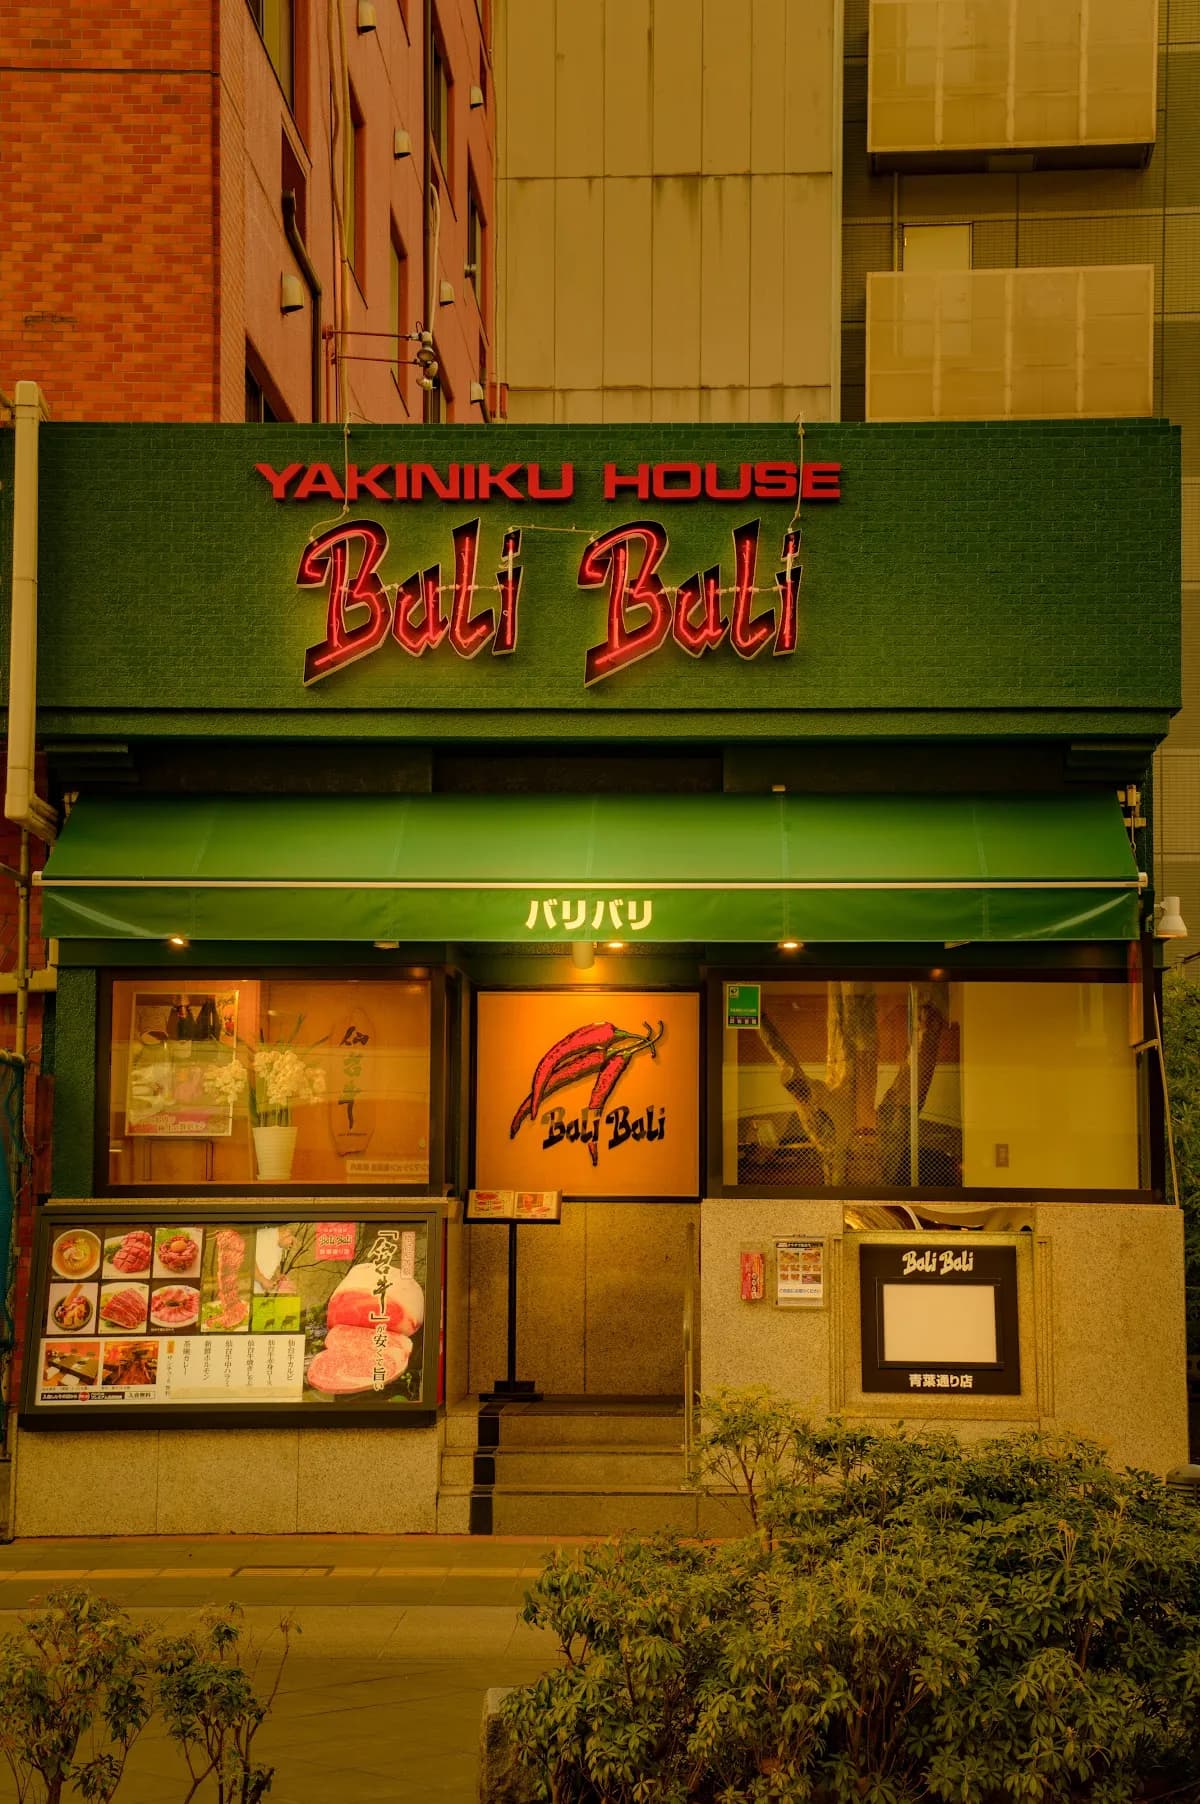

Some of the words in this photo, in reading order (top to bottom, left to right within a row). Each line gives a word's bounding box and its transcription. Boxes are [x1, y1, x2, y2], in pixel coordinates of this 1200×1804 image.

[255, 463, 574, 499] YAKINIKU
[604, 463, 841, 499] HOUSE
[296, 517, 521, 687] Bali
[576, 518, 802, 688] Bali
[525, 898, 652, 930] バリバリ
[541, 1106, 600, 1150] Bali
[605, 1105, 665, 1150] Bali
[902, 1250, 937, 1276] Bali
[939, 1250, 974, 1276] Bali
[909, 1374, 973, 1388] 青葉通り店
